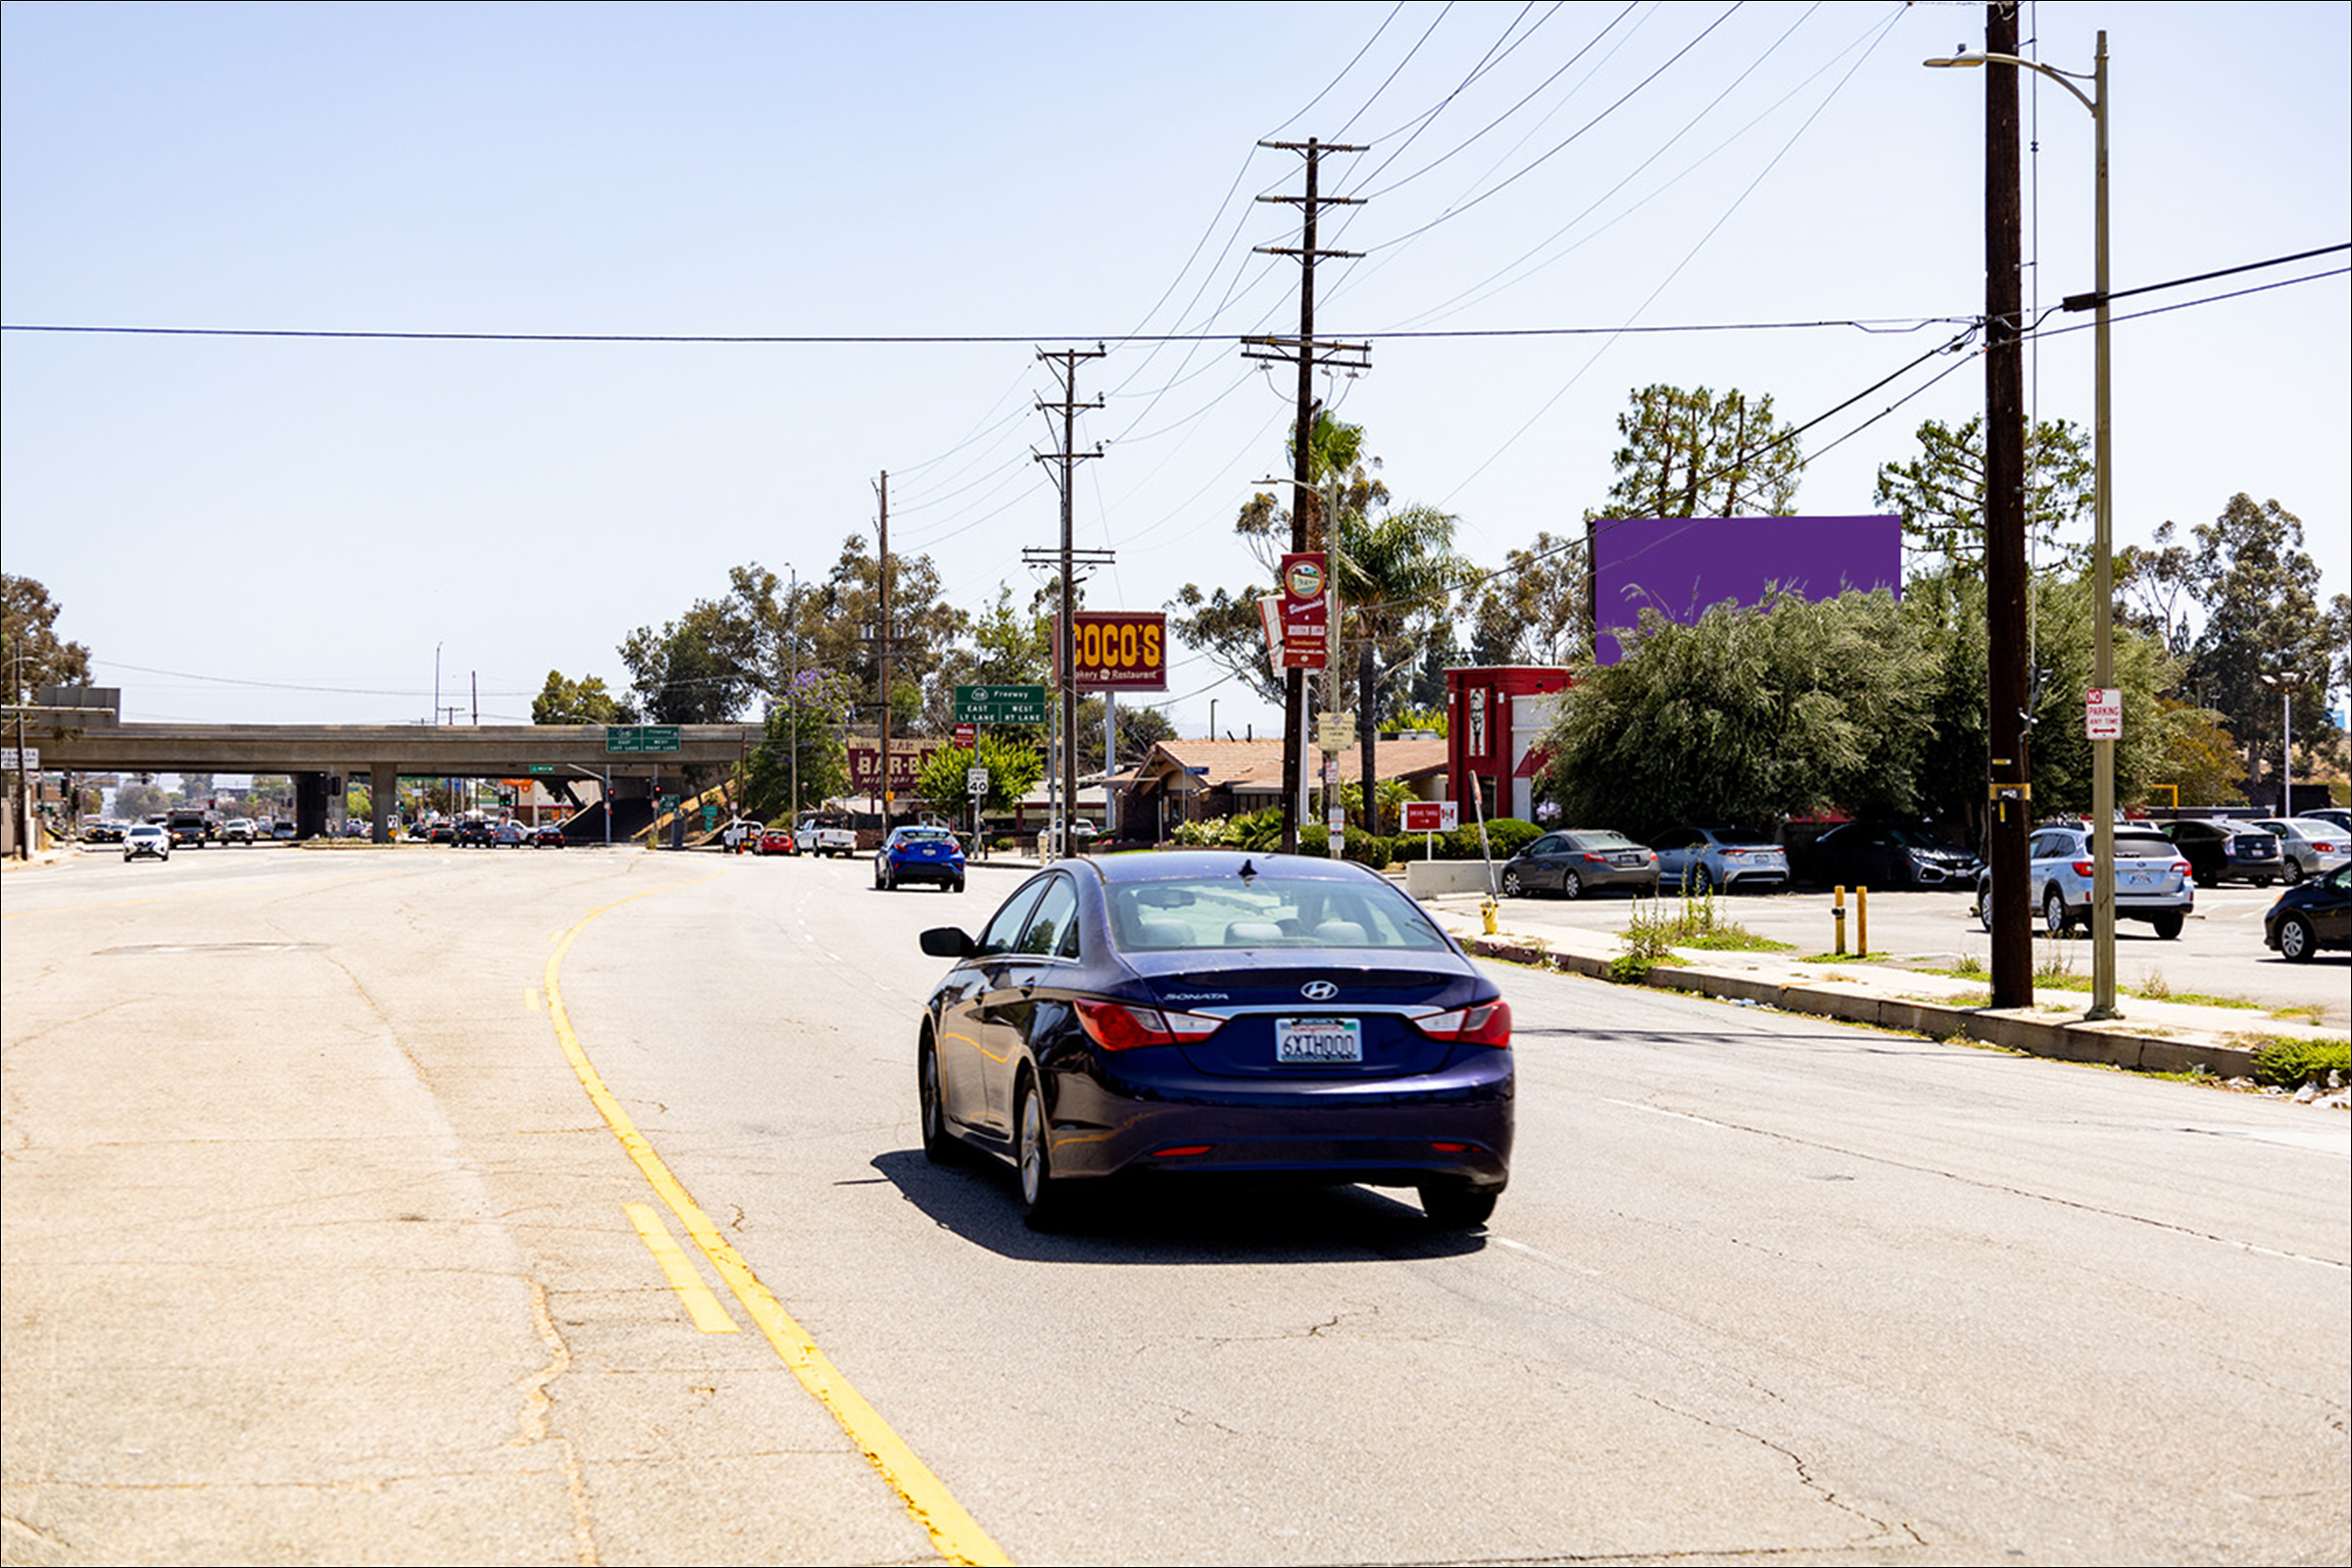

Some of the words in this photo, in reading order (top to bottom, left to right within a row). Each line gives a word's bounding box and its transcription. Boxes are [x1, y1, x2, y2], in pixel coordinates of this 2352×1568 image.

[1075, 669, 1098, 680] akery
[1111, 668, 1156, 679] Restaurant
[994, 690, 1029, 700] Freeway
[2088, 691, 2100, 703] NO
[2088, 706, 2119, 716] PARKING
[969, 782, 987, 792] 40
